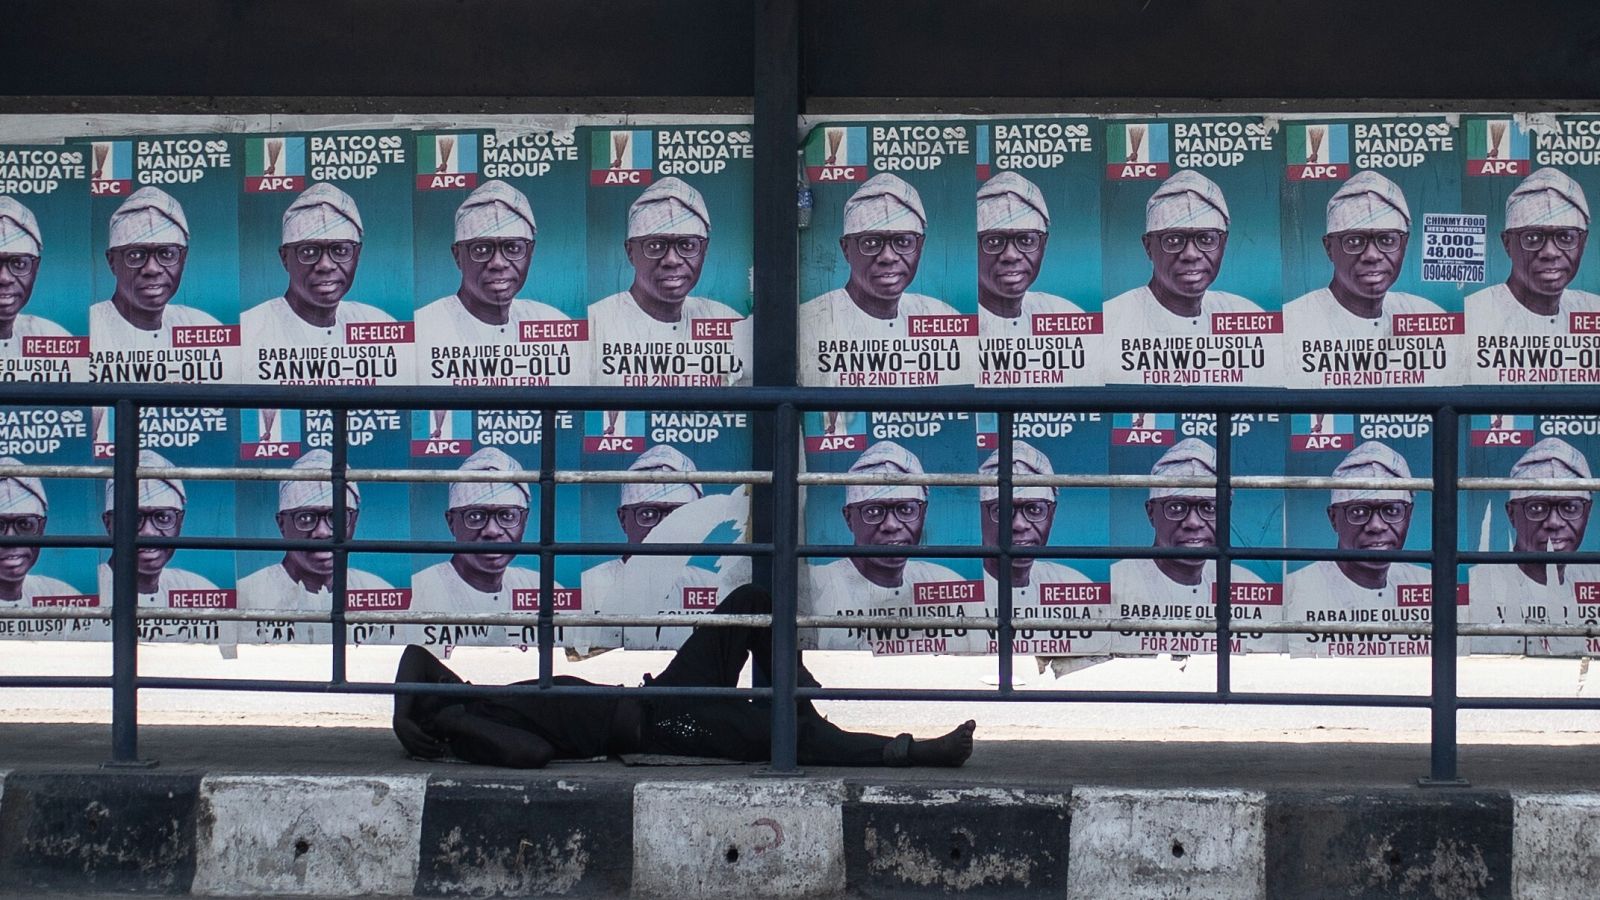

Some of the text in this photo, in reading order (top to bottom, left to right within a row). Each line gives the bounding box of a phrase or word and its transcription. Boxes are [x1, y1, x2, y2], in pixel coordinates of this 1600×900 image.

[872, 126, 938, 140] BATCO
[994, 124, 1060, 140] BATCO
[1174, 122, 1242, 138] BATCO
[1354, 122, 1422, 138] BATCO
[310, 136, 374, 150] BATCO
[658, 130, 722, 145] BATCO
[1174, 136, 1272, 152] MANDATE
[1536, 134, 1600, 150] MANDA
[138, 140, 201, 155] BATCO
[658, 144, 754, 160] MANDATE
[872, 140, 970, 156] MANDATE
[994, 138, 1092, 154] MANDATE
[1355, 137, 1453, 154] MANDATE
[310, 150, 405, 166] MANDATE
[483, 146, 578, 162] MANDATE
[1175, 152, 1244, 168] GROUP
[1356, 153, 1425, 168] GROUP
[138, 154, 231, 170] MANDATE
[658, 160, 726, 174] GROUP
[873, 156, 942, 171] GROUP
[996, 154, 1064, 169] GROUP
[1481, 161, 1518, 174] APC
[138, 169, 204, 184] GROUP
[311, 166, 378, 180] GROUP
[484, 162, 550, 178] GROUP
[819, 168, 855, 180] APC
[1120, 164, 1157, 178] APC
[1301, 166, 1338, 179] APC
[258, 178, 294, 190] APC
[430, 175, 466, 188] APC
[604, 172, 640, 184] APC
[1426, 216, 1484, 226] CHIMMY FOOD
[1424, 264, 1484, 282] 09048467206
[696, 322, 734, 336] RE-EL
[913, 318, 969, 334] RE-ELECT
[1036, 316, 1093, 332] RE-ELECT
[1216, 316, 1273, 330] RE-ELECT
[1398, 317, 1454, 332] RE-ELECT
[176, 328, 232, 344] RE-ELECT
[350, 326, 406, 340] RE-ELECT
[524, 324, 579, 338] RE-ELECT
[26, 340, 80, 354] RE-ELECT
[602, 342, 732, 356] BABAJIDE OLUSOL
[818, 338, 958, 352] BABAJIDE OLUSOLA
[1016, 337, 1084, 350] OLUSOLA
[1122, 336, 1263, 350] BABAJIDE OLUSOLA
[1302, 337, 1444, 352] BABAJIDE OLUSOLA
[1478, 336, 1600, 348] BABAJIDE OLUSO
[157, 349, 222, 362] OLUSOLA
[258, 346, 396, 360] BABAJIDE OLUSOLA
[432, 344, 569, 359] BABAJIDE OLUSOLA
[7, 359, 70, 372] OLUSOLA
[818, 352, 960, 372] SANWO-OLU
[979, 350, 1085, 370] NWO-OLU
[1121, 349, 1264, 370] SANWO-OLU
[1302, 350, 1446, 372] SANWO-OLU
[258, 358, 397, 380] SANWO-OLU
[431, 356, 571, 378] SANWO-OLU
[624, 374, 722, 386] FOR 2ND TERM
[840, 372, 938, 386] FOR 2ND TERM
[994, 370, 1020, 384] 2ND
[1024, 370, 1064, 384] TERM
[1144, 370, 1243, 384] FOR 2ND TERM
[1324, 370, 1424, 386] FOR 2ND TERM
[1499, 368, 1600, 382] FOR 2ND TERM
[306, 416, 400, 432] MADATE
[651, 414, 746, 428] MANDATE
[652, 428, 719, 442] GROUP
[873, 422, 942, 438] GROUP
[1360, 424, 1430, 439] GROUP
[307, 432, 374, 447] GRUP
[478, 430, 542, 445] GROUP
[598, 438, 632, 450] APC
[820, 438, 855, 450] APC
[1126, 432, 1162, 444] APC
[1306, 436, 1342, 448] APC
[1485, 432, 1521, 444] APC
[254, 444, 290, 457] APC
[425, 442, 460, 454] APC
[918, 584, 975, 600] RE-ELECT
[1045, 586, 1101, 600] RE-ELECT
[1231, 587, 1273, 600] -ELECT
[174, 592, 228, 608] RE-ELECT
[348, 592, 402, 607] RE-ELECT
[1120, 604, 1192, 618] BABAJIDE
[1306, 608, 1430, 622] BABAJIDE OLUSO
[876, 638, 946, 654] 2ND TERM
[1032, 640, 1071, 653] TERM
[1141, 638, 1240, 652] FOR 2ND TEM
[1328, 642, 1429, 656] FOR 2ND TERM
